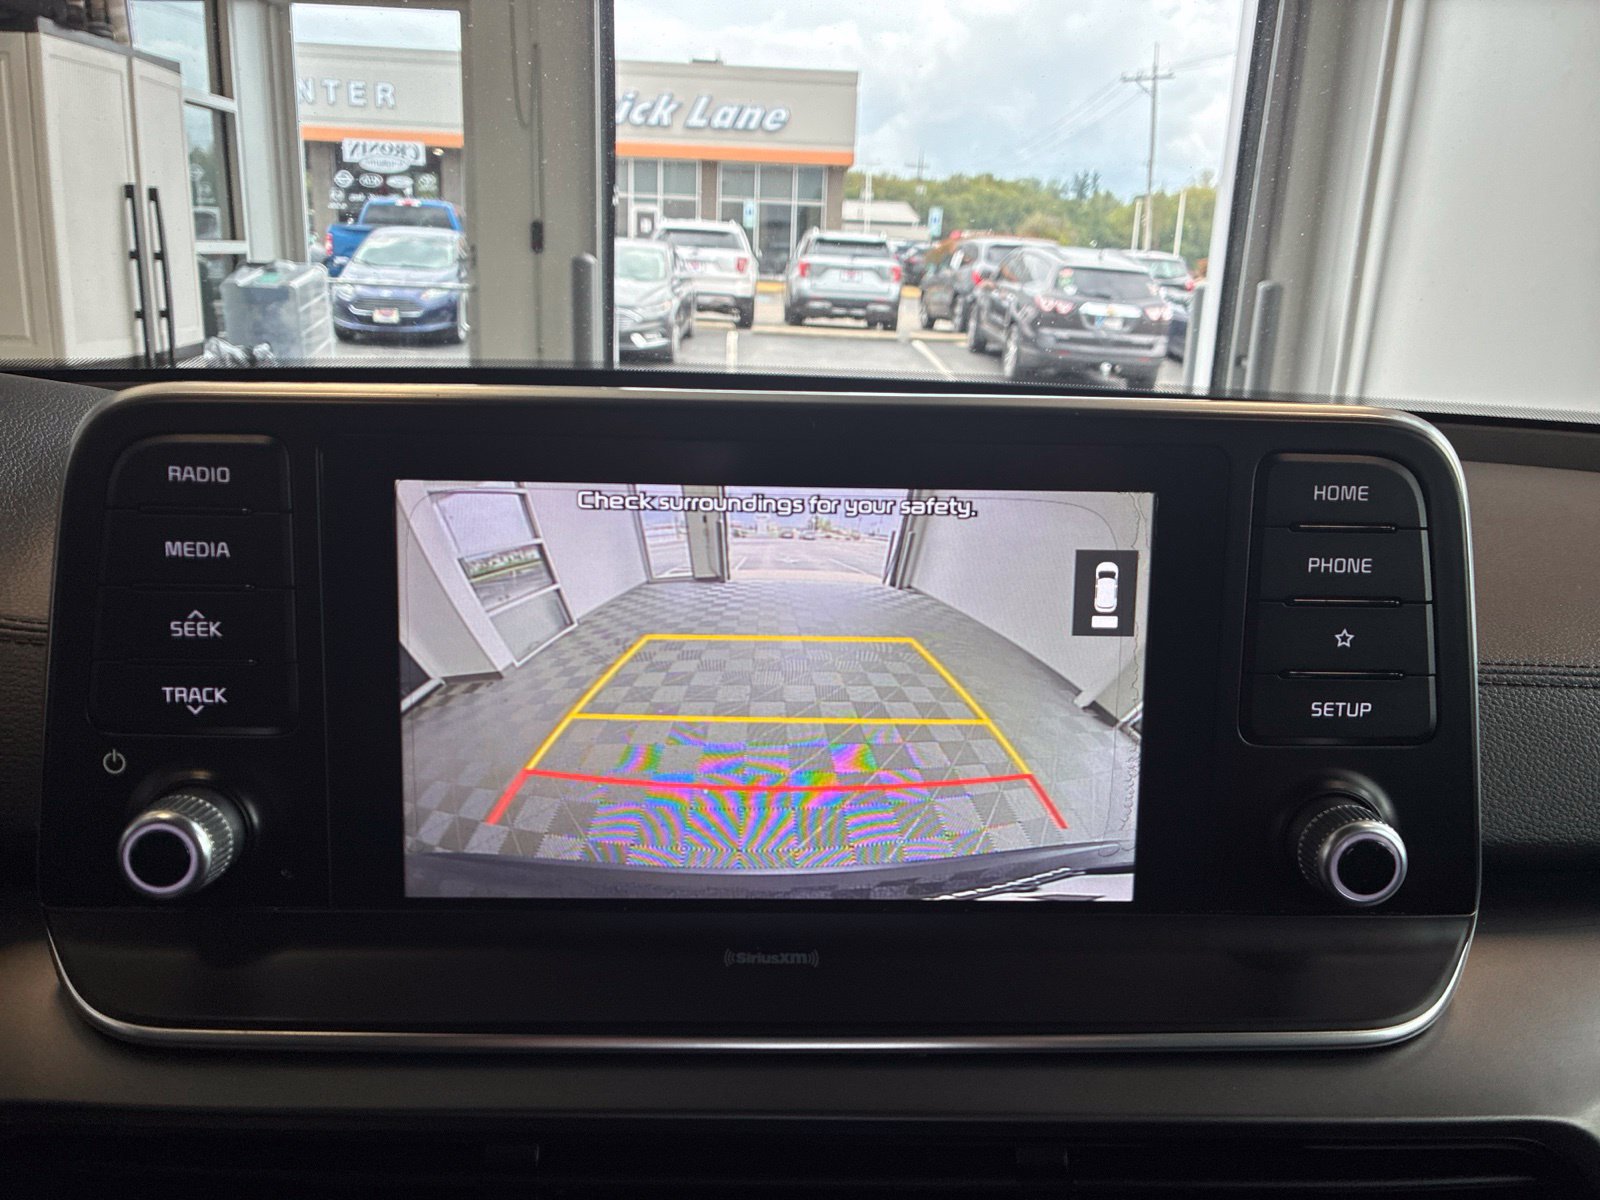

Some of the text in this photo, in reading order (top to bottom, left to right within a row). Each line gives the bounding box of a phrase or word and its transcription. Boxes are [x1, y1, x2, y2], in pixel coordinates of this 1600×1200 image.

[684, 94, 791, 132] Lane
[167, 465, 230, 483] RADIO
[1313, 485, 1369, 501] HOME
[577, 490, 978, 519] Check surroundings for your safety.
[164, 541, 230, 558] MEDIA
[1307, 557, 1372, 573] PHONE
[170, 621, 222, 637] SEEK
[162, 687, 227, 704] TRACK
[1311, 702, 1372, 718] SETUP
